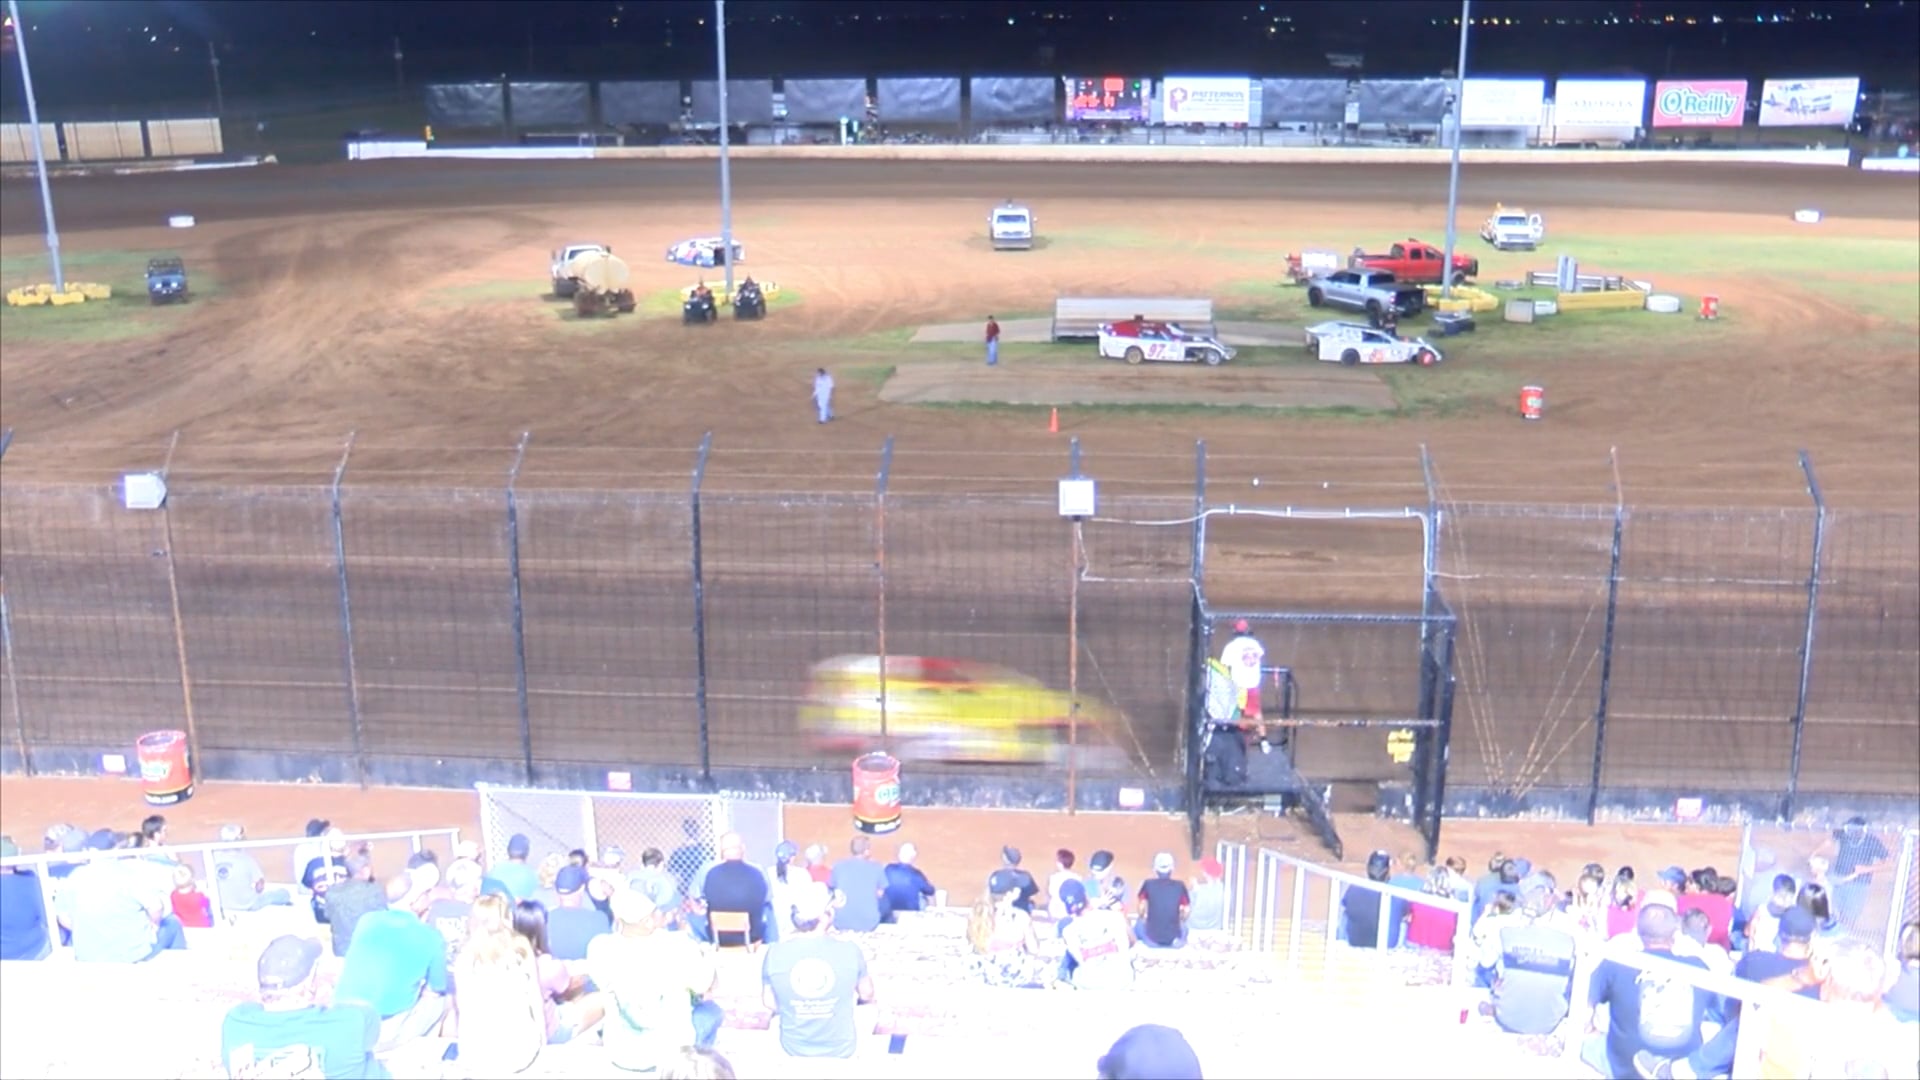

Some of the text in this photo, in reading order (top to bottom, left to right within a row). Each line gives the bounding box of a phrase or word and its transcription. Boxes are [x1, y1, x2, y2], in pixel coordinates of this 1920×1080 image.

[1191, 90, 1245, 98] PATTERSON
[1661, 88, 1736, 116] O'Reilly
[1147, 343, 1167, 358] 97
